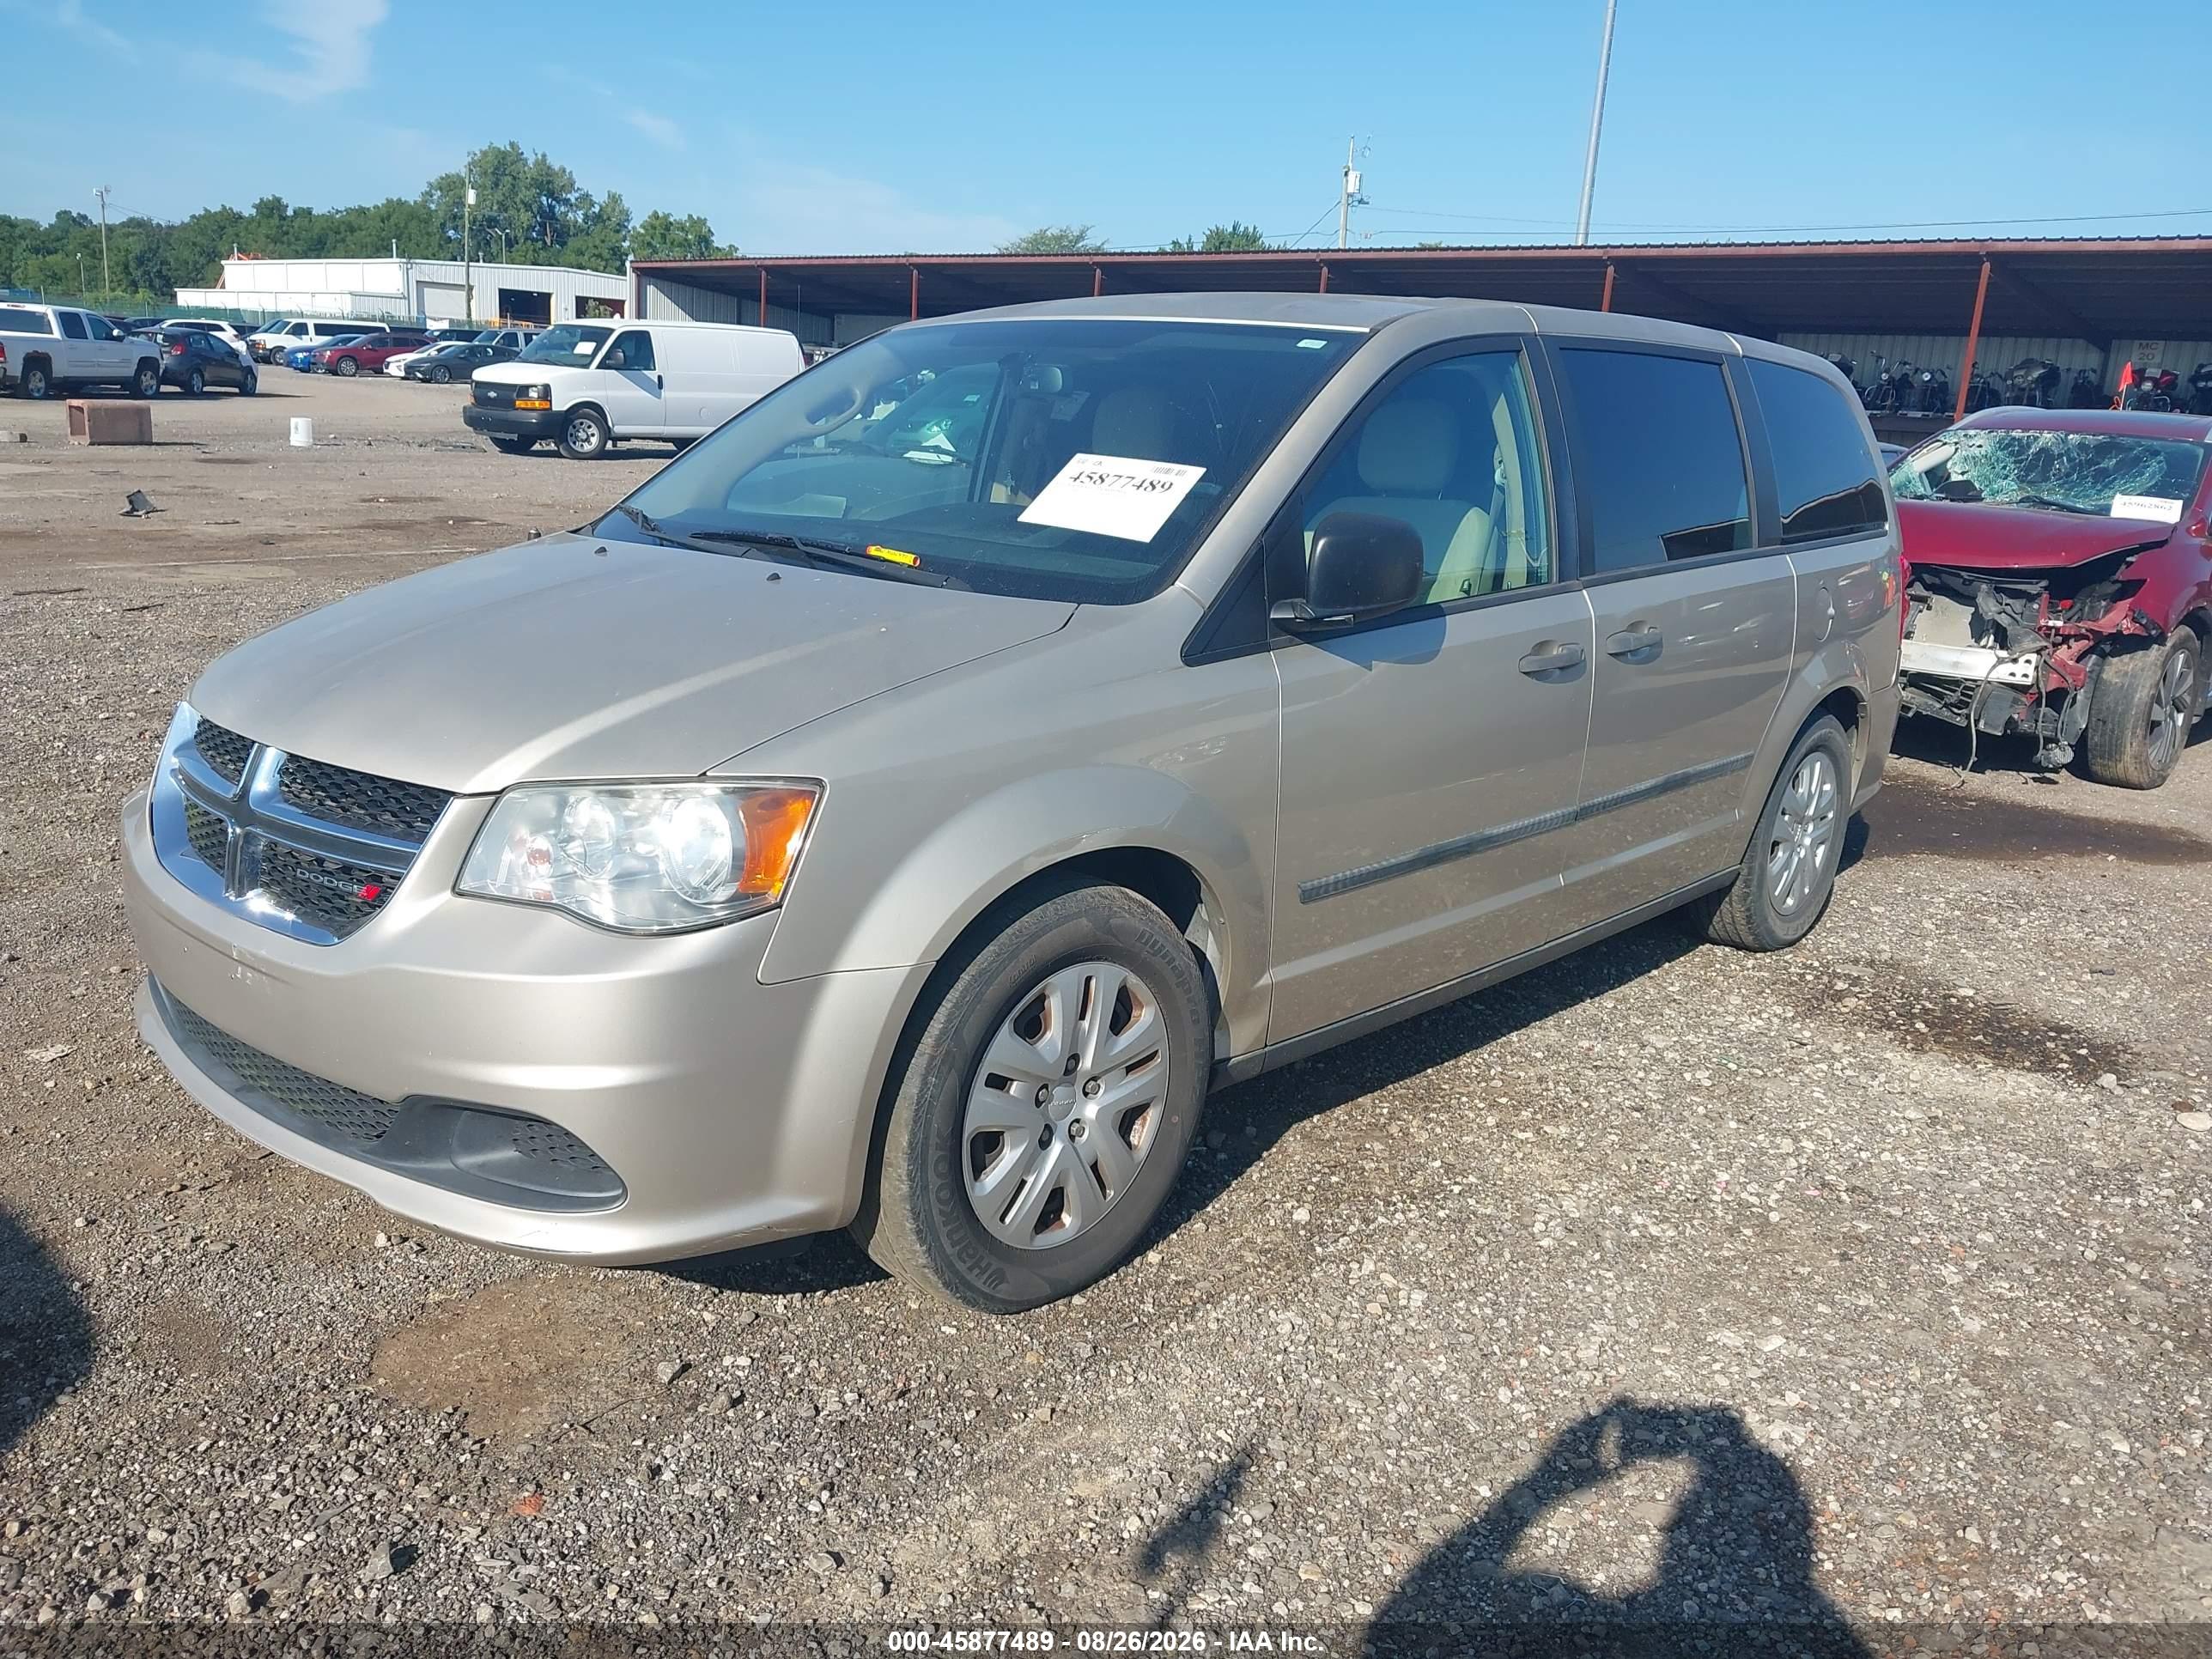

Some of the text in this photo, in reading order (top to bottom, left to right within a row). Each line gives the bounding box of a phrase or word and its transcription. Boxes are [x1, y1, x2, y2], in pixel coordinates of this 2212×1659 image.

[2138, 342, 2158, 350] MC
[2138, 352, 2155, 361] 20
[1070, 471, 1174, 493] 45877489
[296, 868, 368, 895] DODGE
